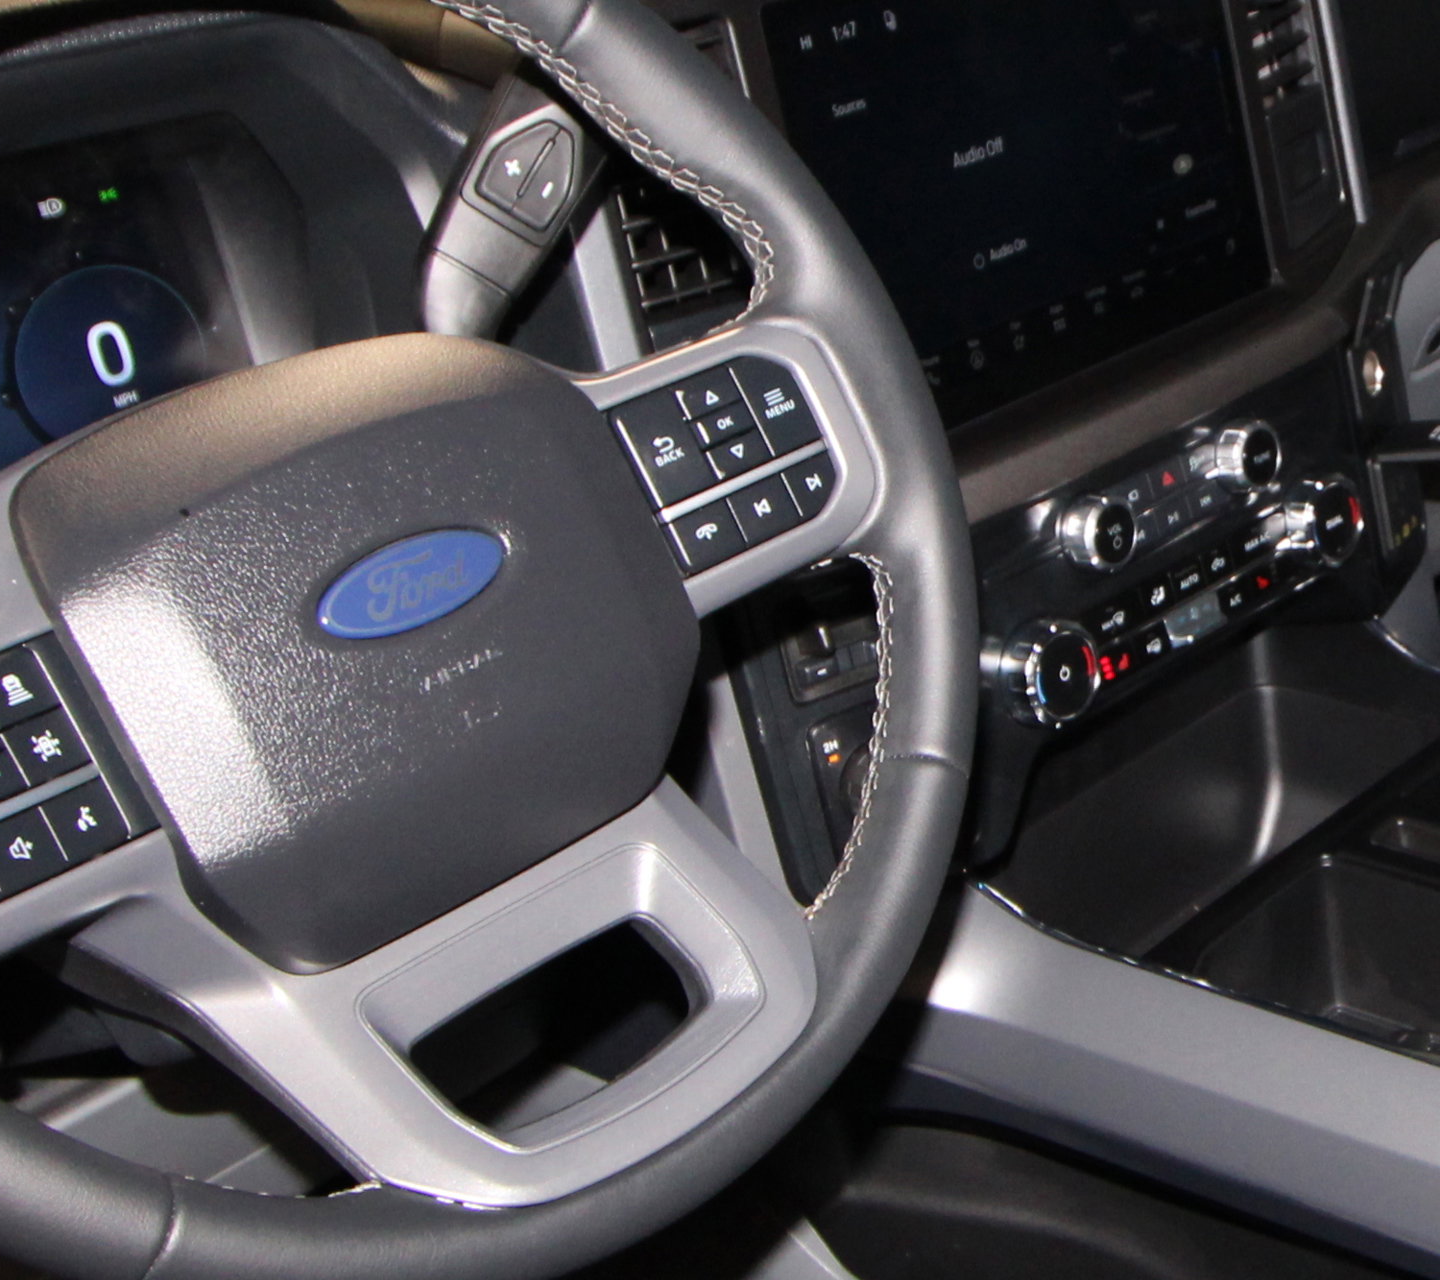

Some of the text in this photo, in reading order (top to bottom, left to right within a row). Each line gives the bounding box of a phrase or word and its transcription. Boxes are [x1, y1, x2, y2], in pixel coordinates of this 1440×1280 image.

[831, 20, 856, 41] 1:47
[831, 99, 866, 117] Sources
[953, 135, 1003, 168] Audio Off
[989, 243, 1014, 261] Audio
[86, 320, 136, 388] 0
[113, 390, 139, 408] MPH
[764, 399, 796, 420] MENU
[716, 416, 735, 430] OK
[654, 448, 686, 468] BACK
[365, 548, 470, 623] Ford
[1180, 573, 1200, 591] AUTO
[822, 738, 840, 754] 2H
